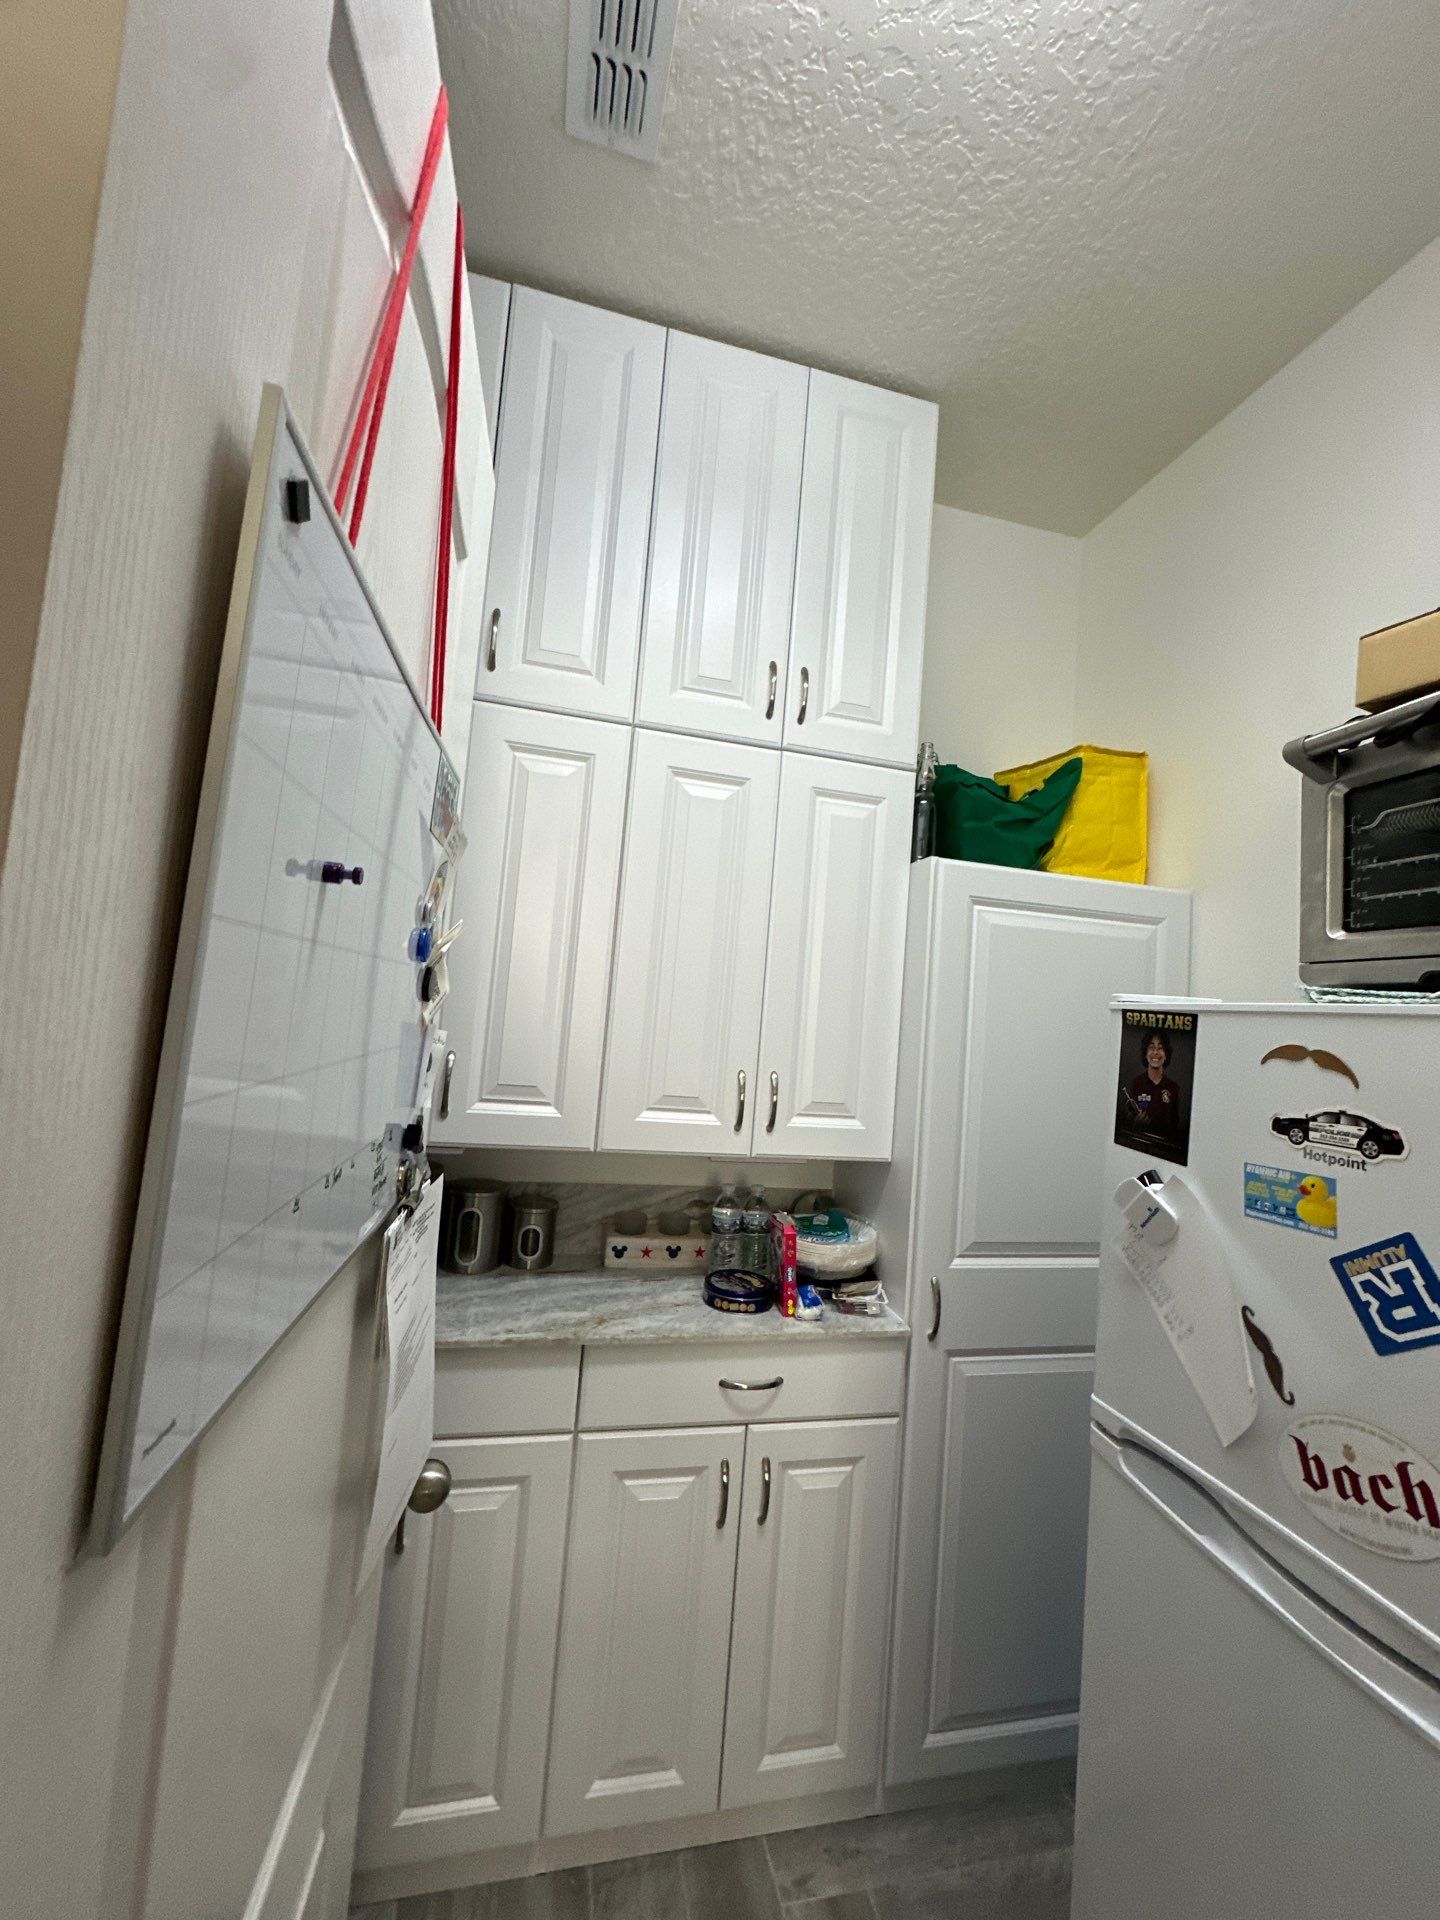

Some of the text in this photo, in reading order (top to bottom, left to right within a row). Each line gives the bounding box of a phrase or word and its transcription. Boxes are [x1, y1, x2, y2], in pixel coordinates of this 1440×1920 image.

[1126, 1012, 1193, 1030] SPARTANS
[1303, 1148, 1368, 1171] Hotpoint
[1342, 1243, 1407, 1277] ALUMNI
[1288, 1434, 1440, 1528] bach
